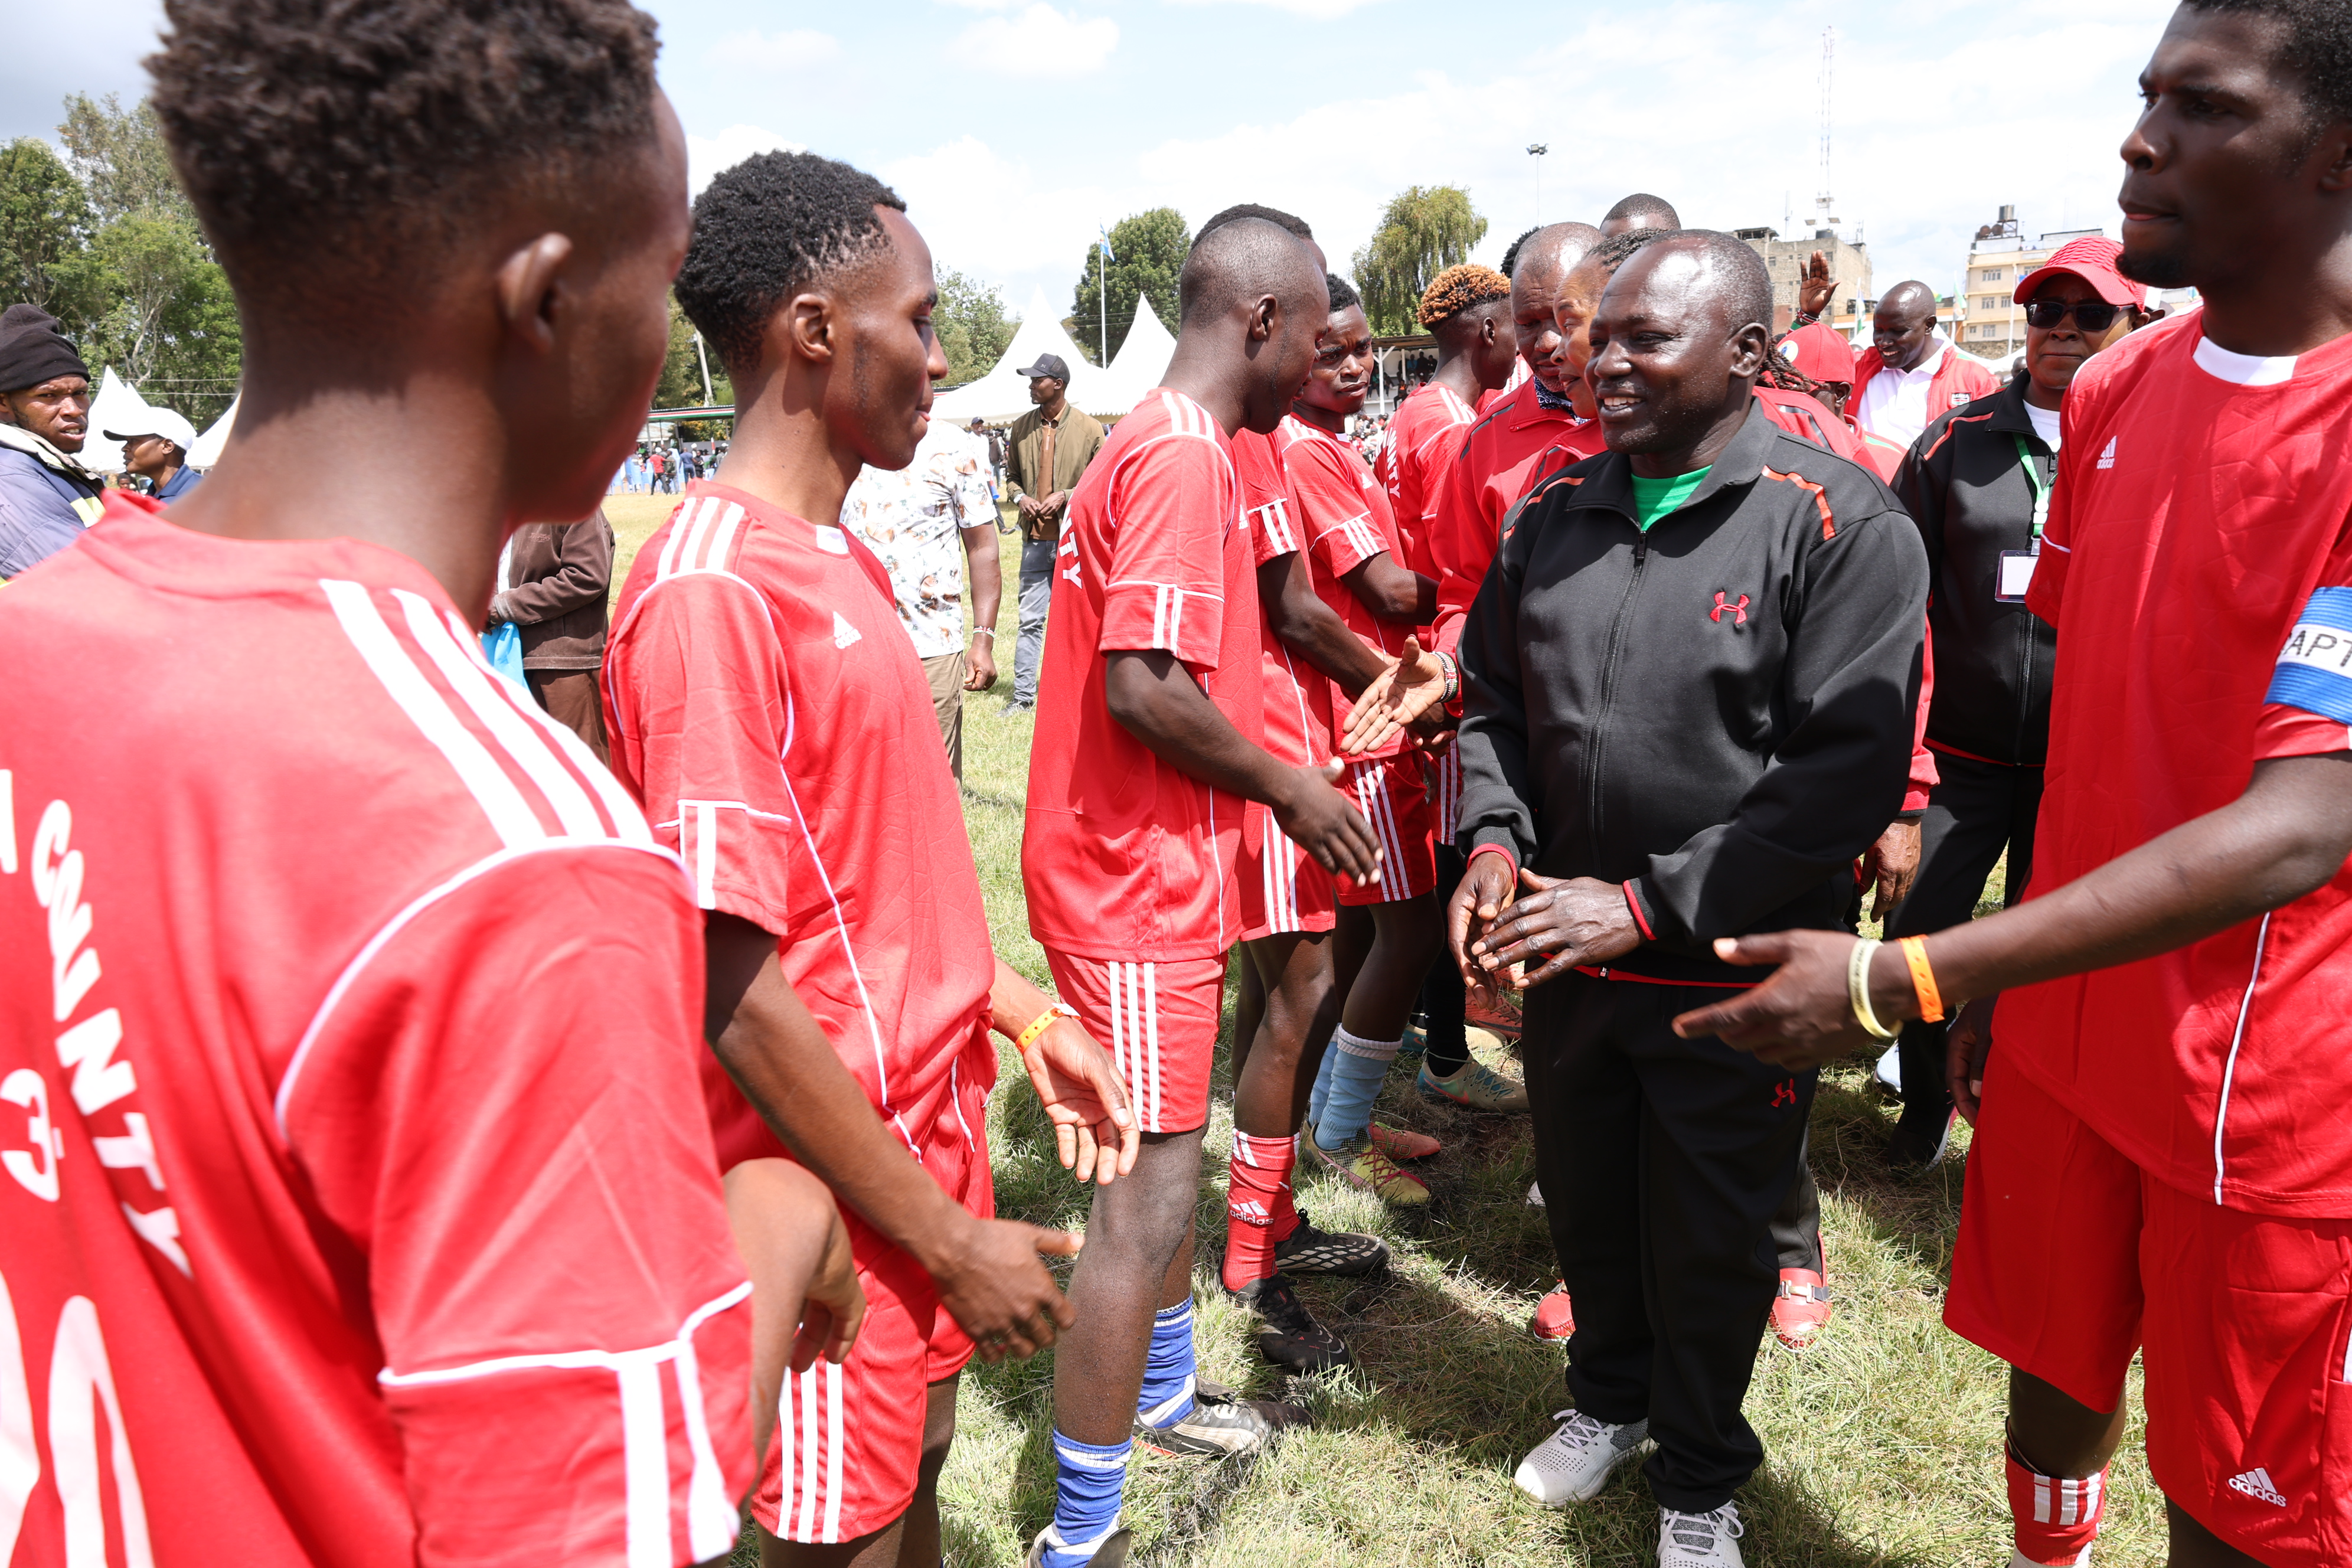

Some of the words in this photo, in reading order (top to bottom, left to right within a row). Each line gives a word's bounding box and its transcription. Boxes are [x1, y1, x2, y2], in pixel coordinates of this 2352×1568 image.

[2281, 630, 2352, 667] APT
[1230, 1210, 1274, 1225] adidas
[1164, 1435, 1182, 1444] SPORT
[2228, 1478, 2286, 1507] adidas
